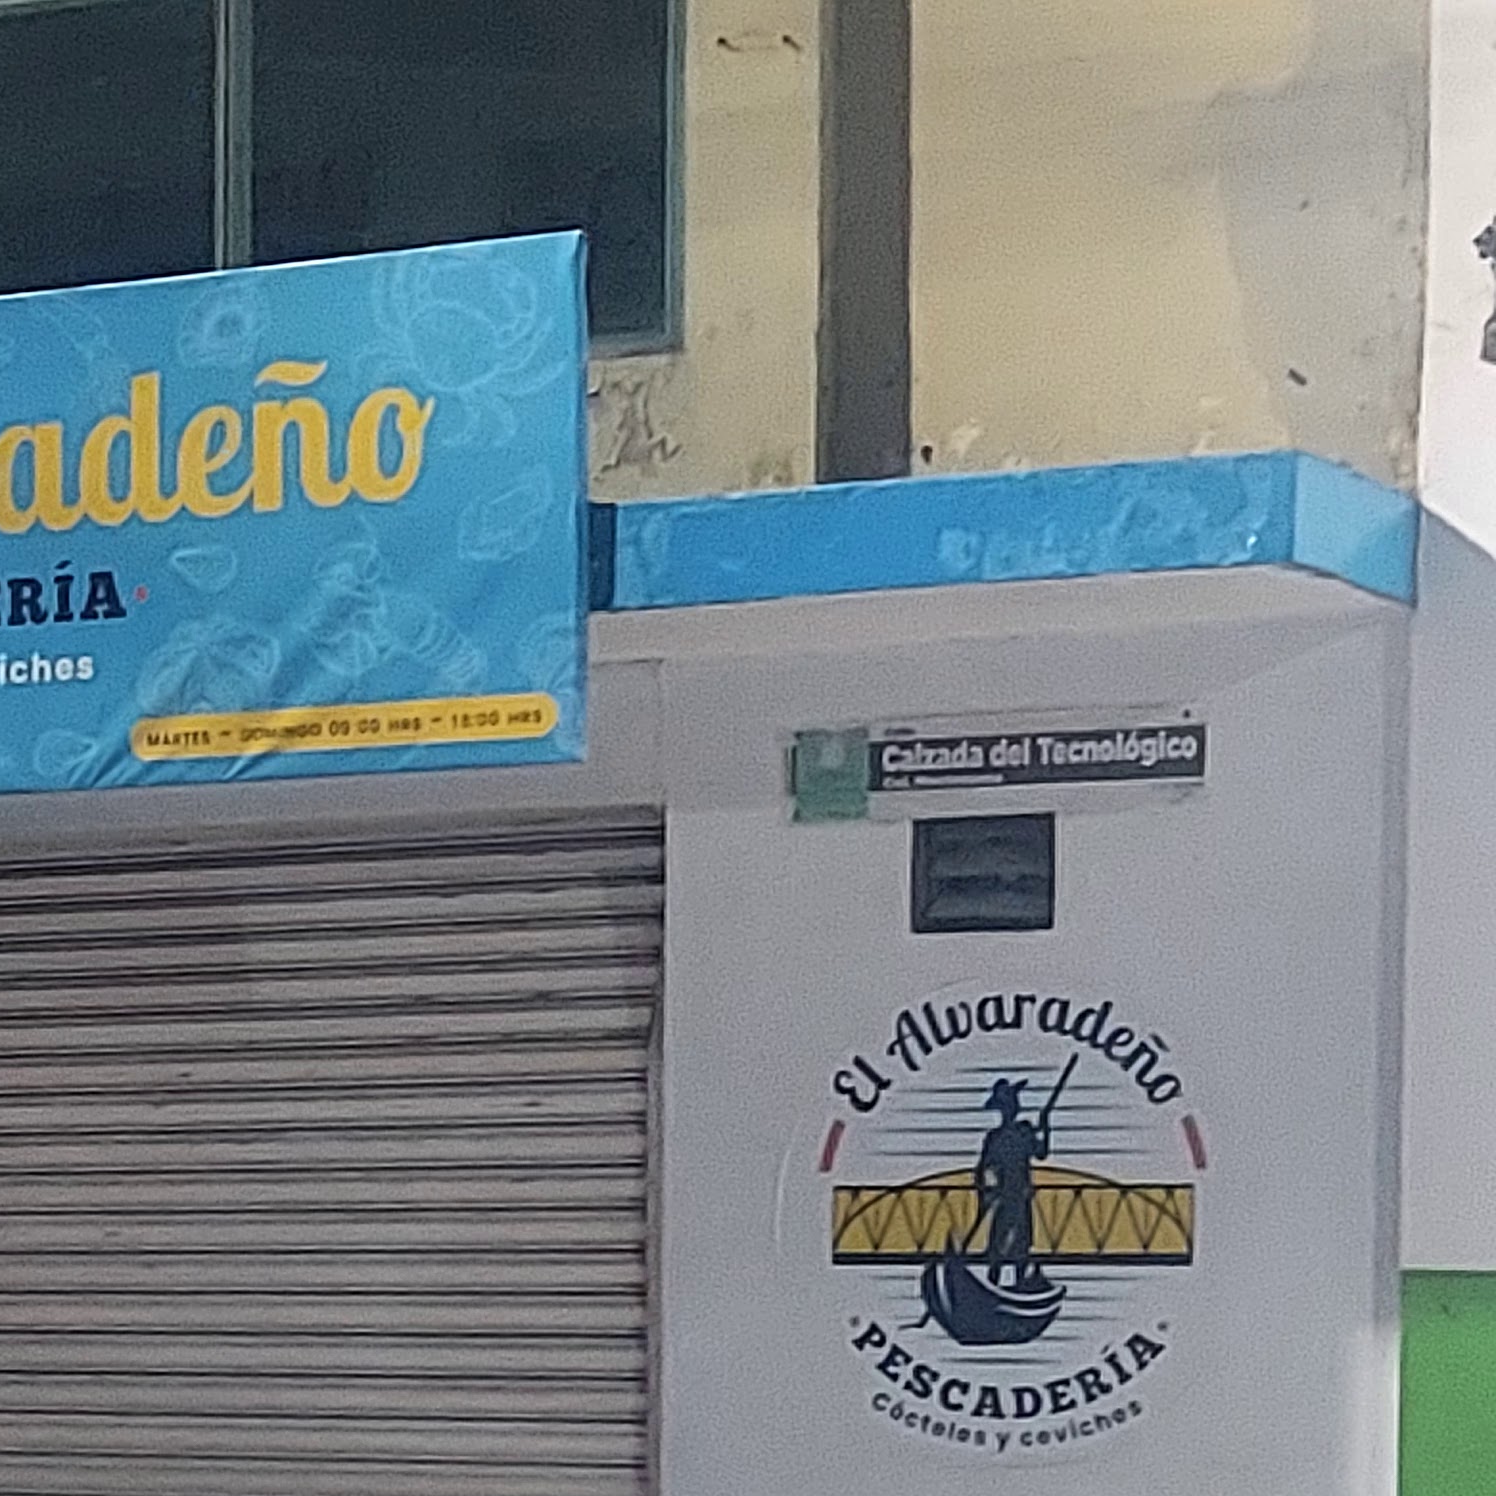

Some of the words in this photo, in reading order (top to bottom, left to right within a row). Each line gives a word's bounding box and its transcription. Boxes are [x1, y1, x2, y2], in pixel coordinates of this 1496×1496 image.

[882, 740, 984, 772] Calzada
[989, 737, 1031, 768] del
[1037, 730, 1198, 766] Tecnológico
[833, 1055, 892, 1113] El
[886, 993, 1184, 1105] Alvaradeño
[851, 1318, 1168, 1419] PESCADERÍA
[871, 1391, 988, 1448] Cócteles
[995, 1429, 1012, 1454] y
[1019, 1400, 1144, 1448] ceviches
